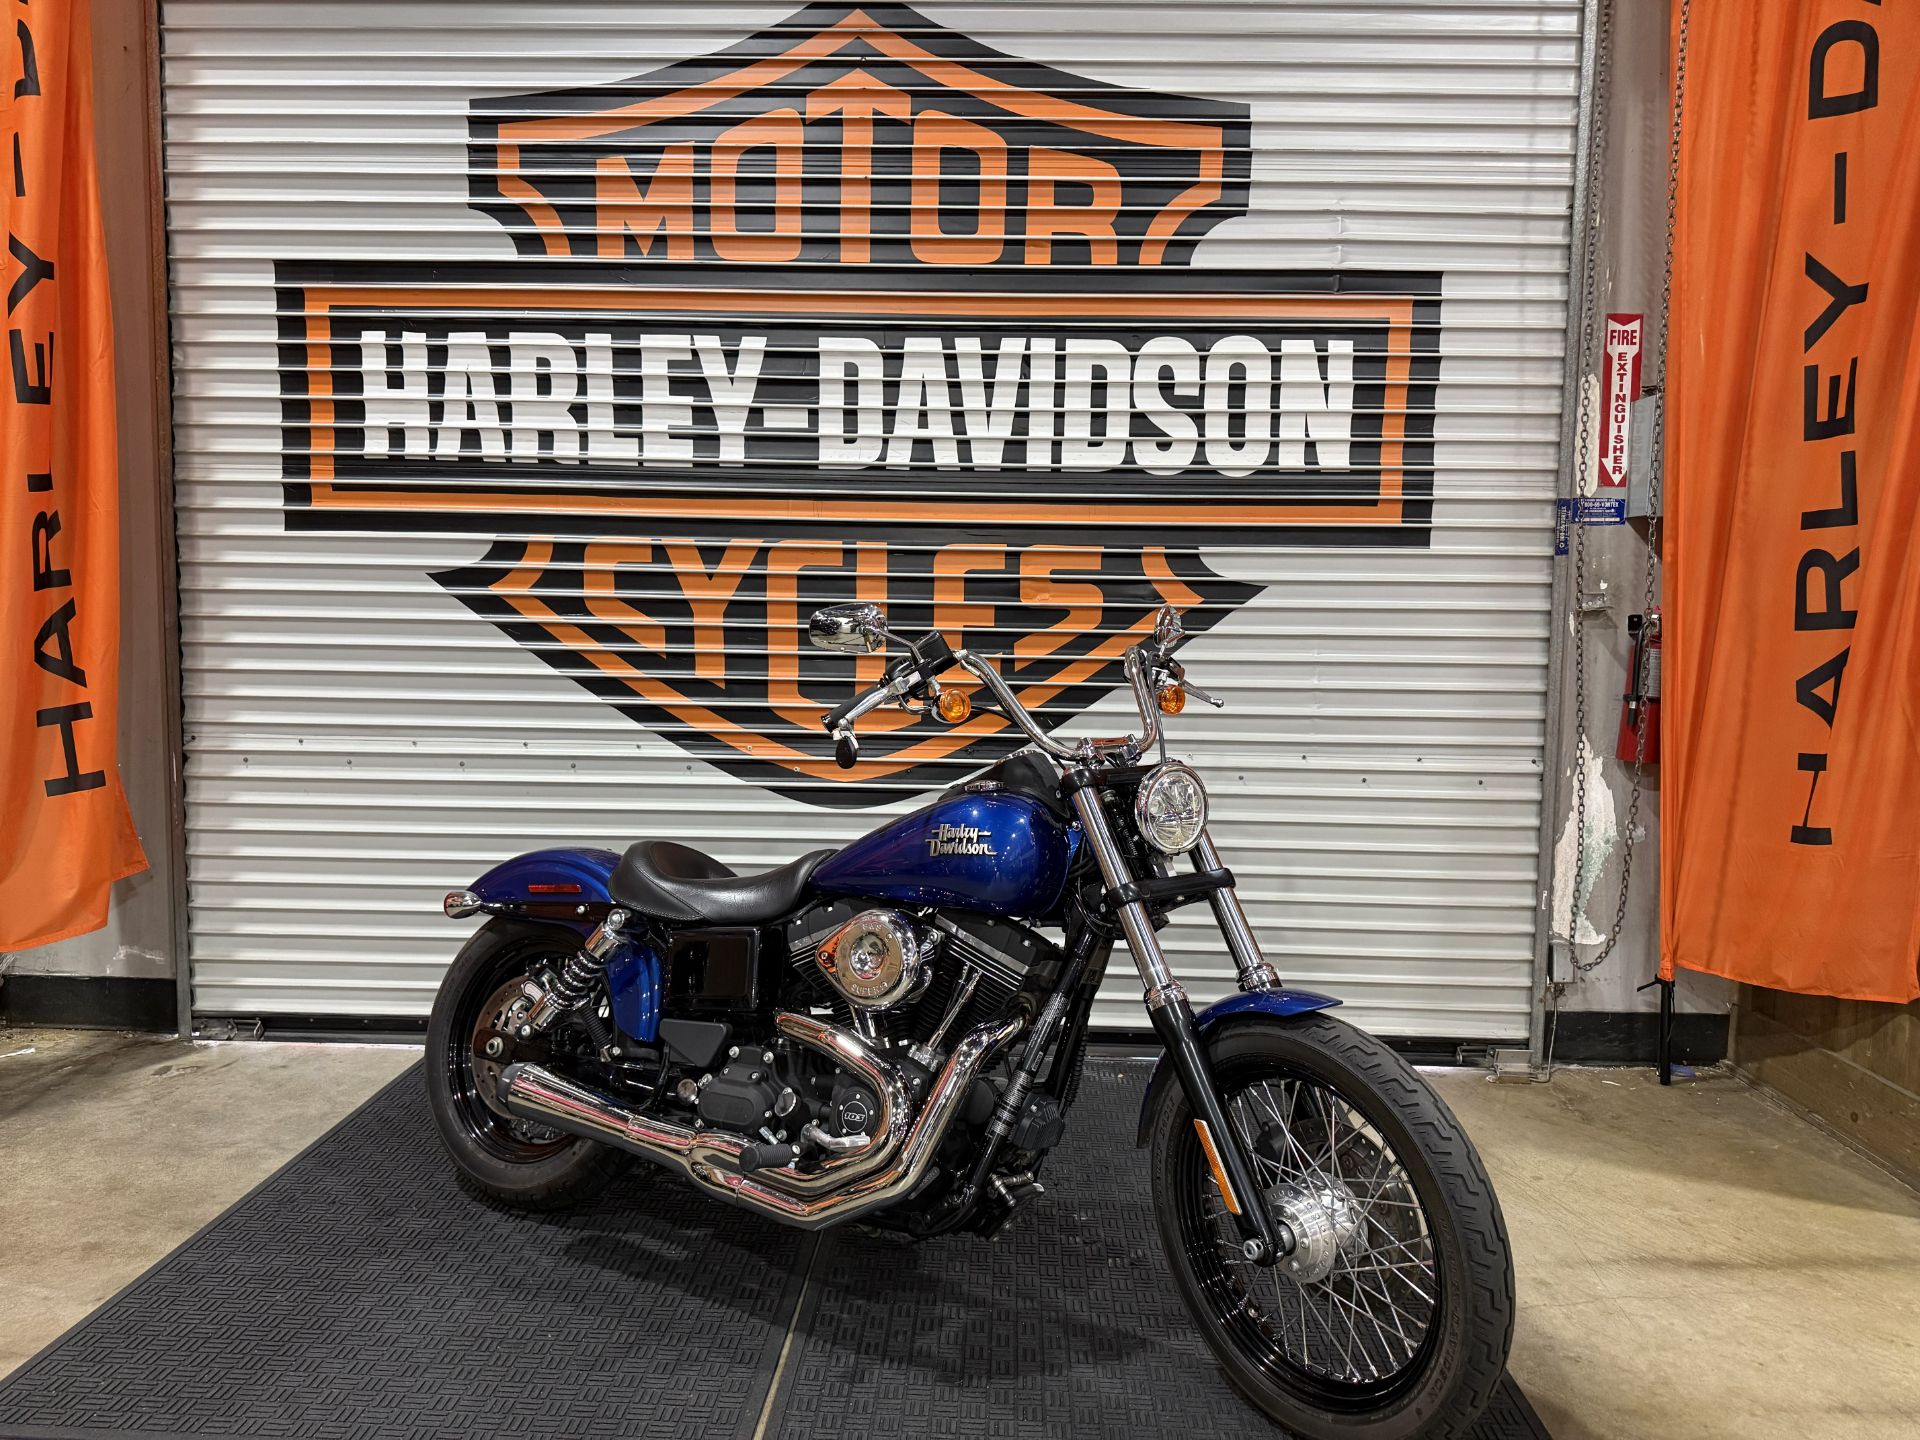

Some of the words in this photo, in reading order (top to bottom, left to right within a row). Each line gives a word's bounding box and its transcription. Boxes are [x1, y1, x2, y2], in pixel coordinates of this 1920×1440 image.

[595, 68, 1120, 265] MOTOR
[359, 330, 1355, 477] HARLEY-DAVIDSON
[1609, 330, 1637, 346] FIRE
[1611, 352, 1628, 475] EXTINGUISHER
[1789, 0, 1882, 846] HARLEY-D
[583, 539, 1105, 735] CYCLES
[925, 837, 998, 857] Davidson
[932, 823, 992, 844] Harley
